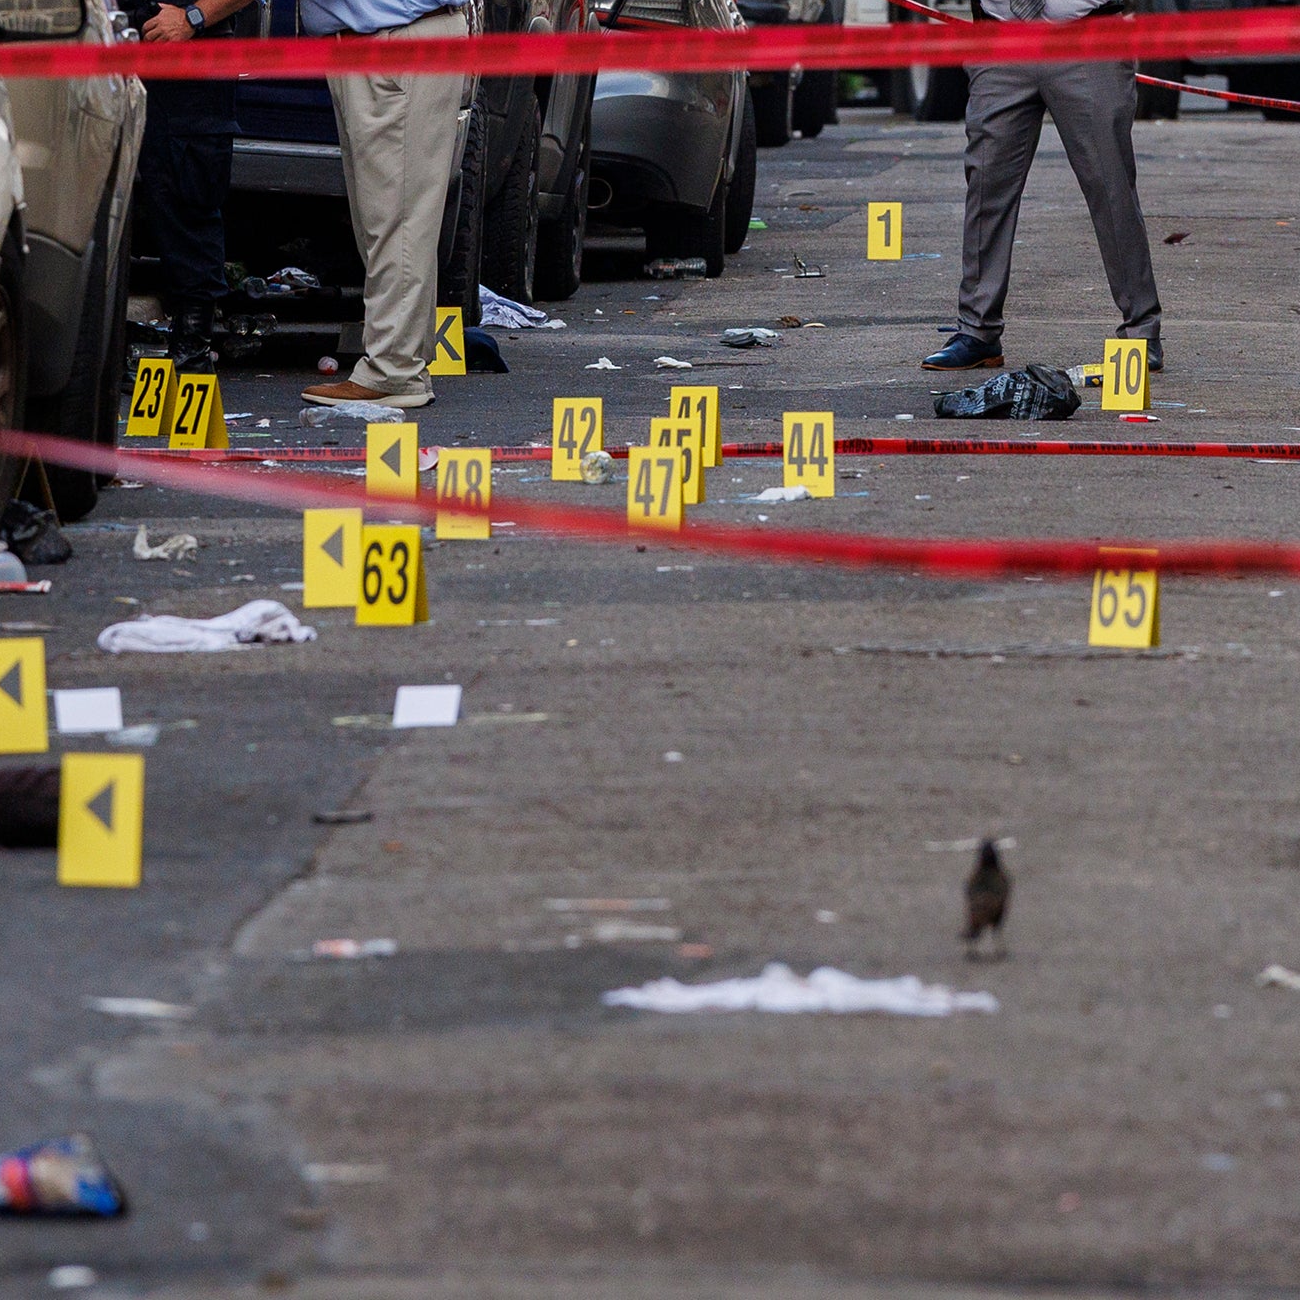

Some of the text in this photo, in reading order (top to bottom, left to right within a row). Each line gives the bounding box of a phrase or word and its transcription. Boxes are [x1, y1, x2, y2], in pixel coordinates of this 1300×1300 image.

[878, 210, 890, 247] 1
[132, 367, 165, 419] 23
[1110, 347, 1142, 396] 10
[174, 383, 209, 435] 27
[559, 407, 596, 460] 42
[788, 424, 829, 477] 44
[444, 460, 482, 512] 48
[635, 459, 674, 516] 47
[363, 541, 409, 606] 63
[1099, 568, 1146, 628] 65
